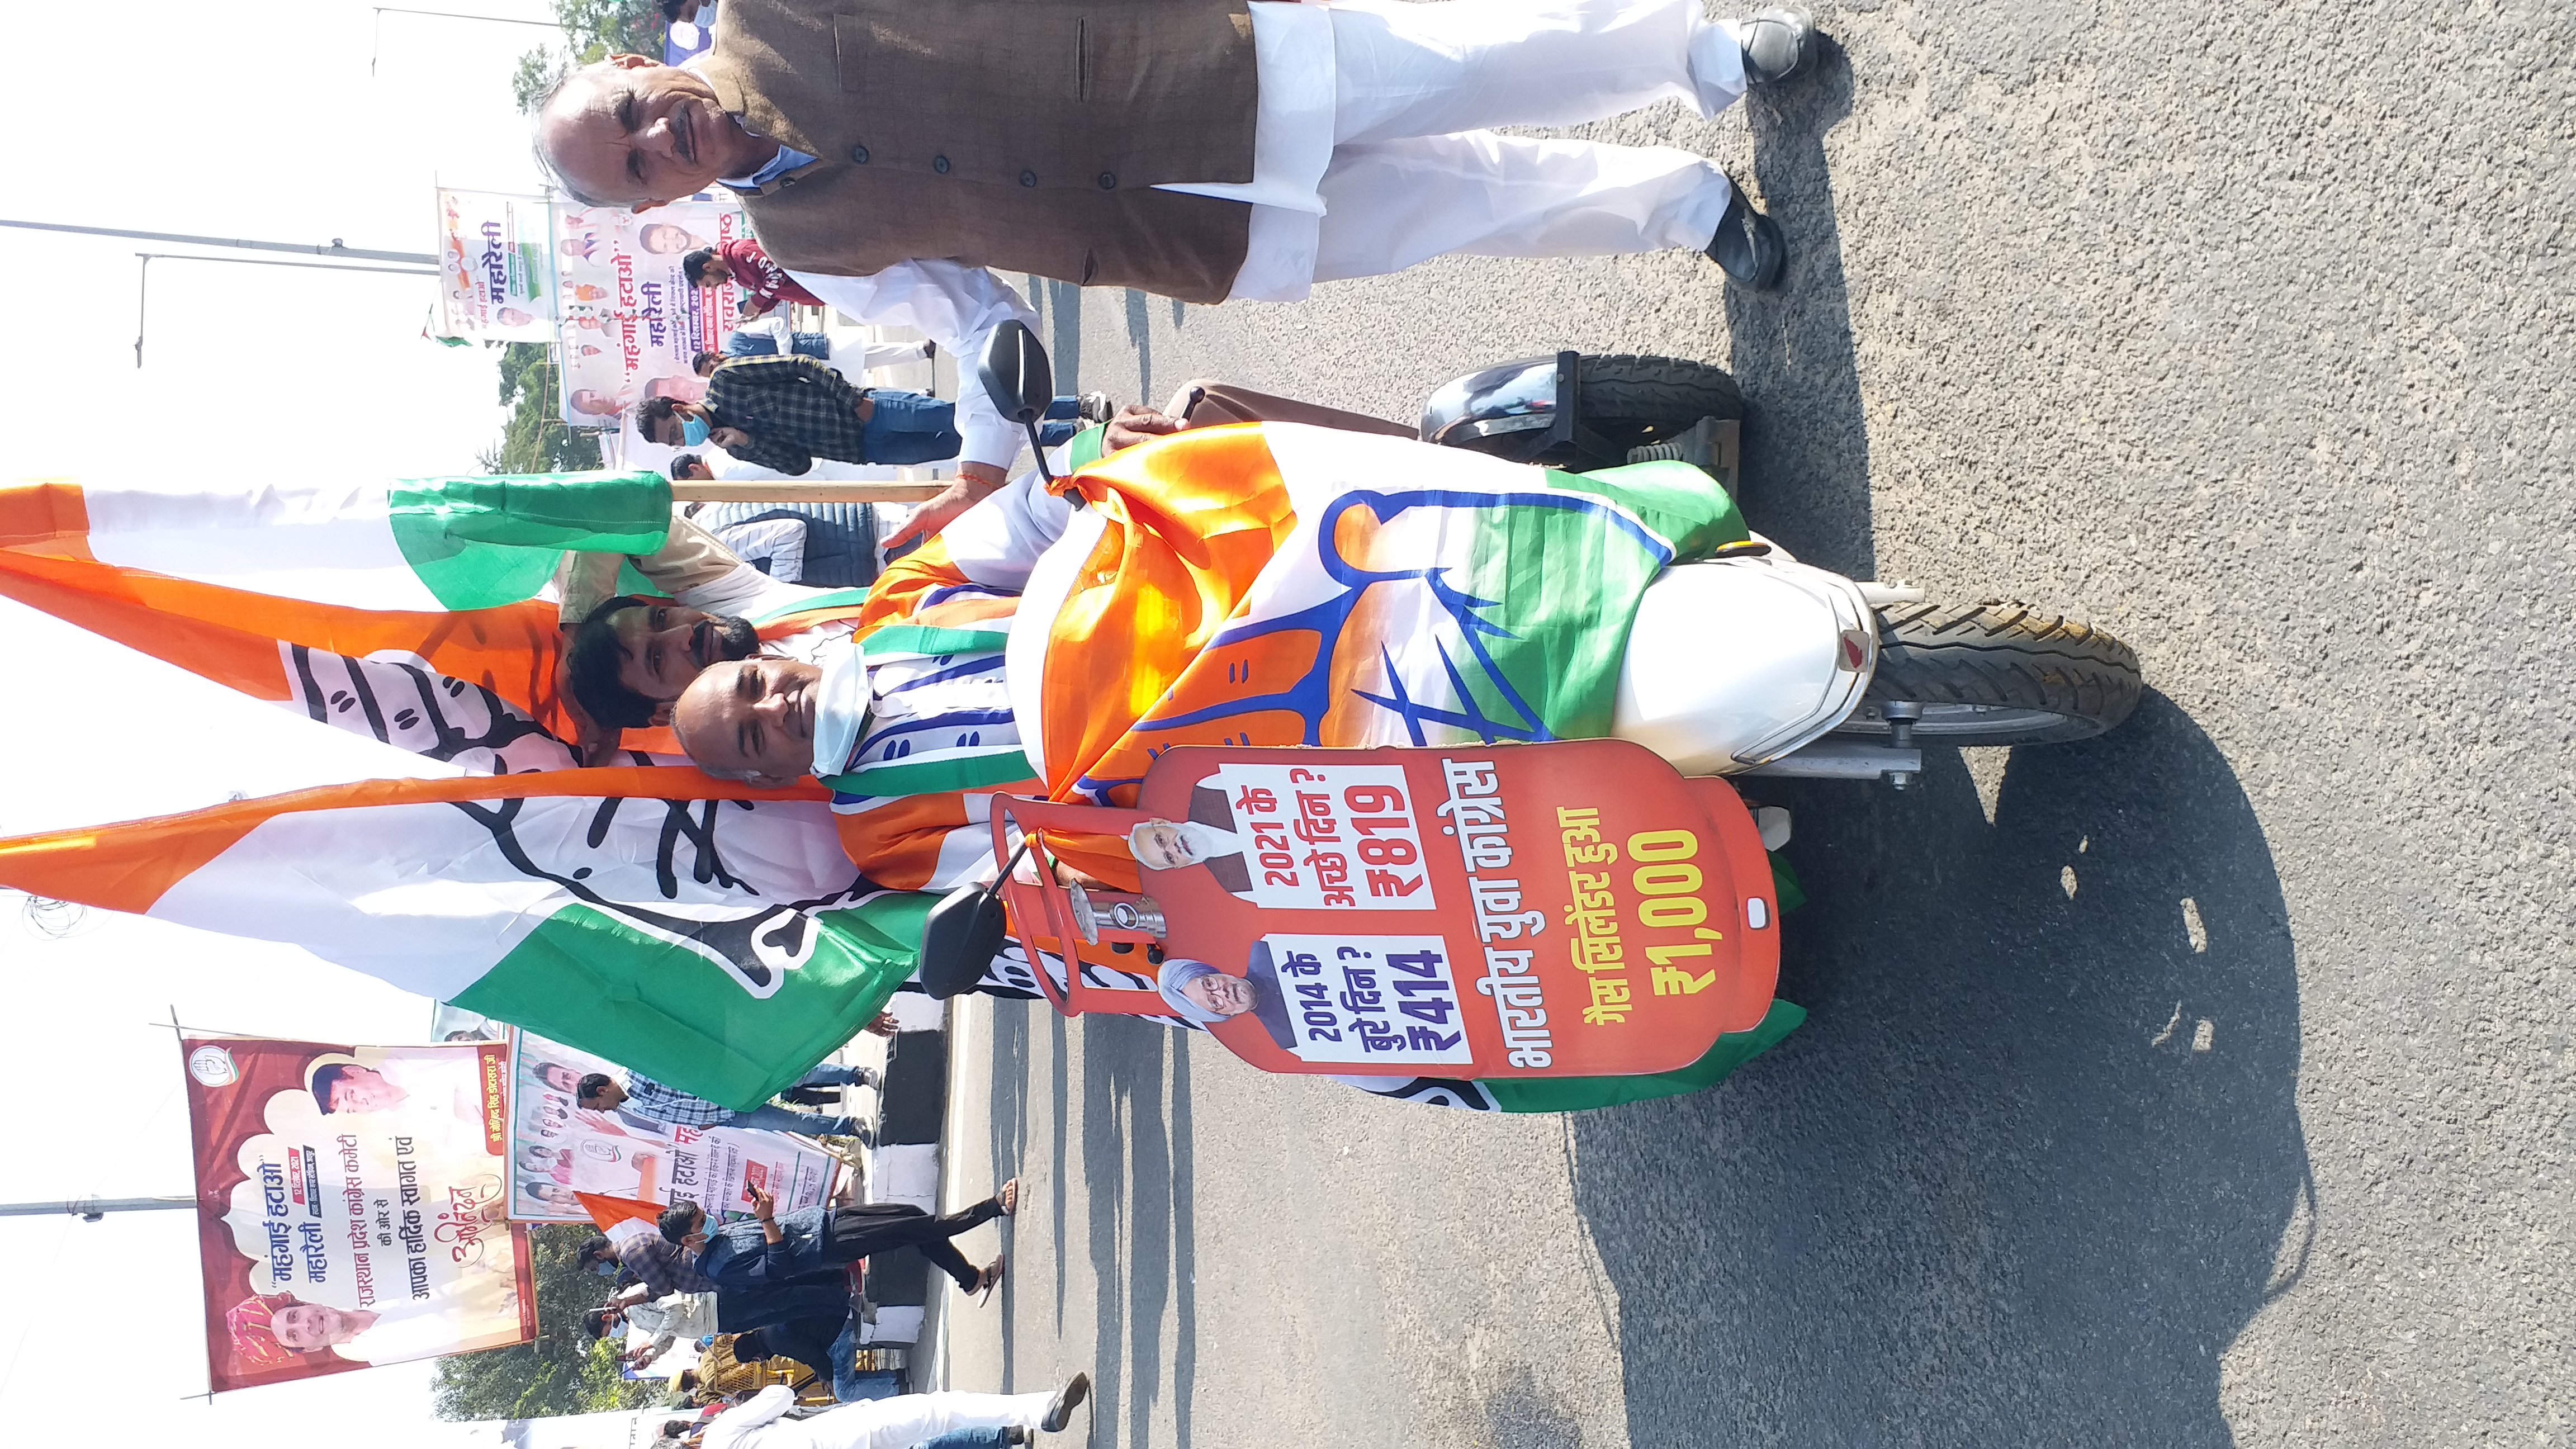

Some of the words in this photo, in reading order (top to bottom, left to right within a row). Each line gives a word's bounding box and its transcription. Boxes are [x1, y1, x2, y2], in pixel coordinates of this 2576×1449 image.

[481, 220, 506, 305] महारैली
[640, 281, 666, 347] महारैली
[691, 288, 699, 307] 202
[693, 341, 701, 349] 12
[1289, 768, 1327, 783] ?
[1236, 784, 1278, 814] के
[1292, 792, 1342, 845] दिन
[1436, 757, 1512, 873] कांग्रेस
[1251, 822, 1300, 887] 2021
[1343, 784, 1424, 897] ₹819
[1556, 806, 1618, 866] हुआ
[1303, 850, 1356, 906] अच्छे
[1469, 878, 1546, 942] युवा
[1564, 872, 1625, 973] सिलेंडर
[1627, 830, 1723, 997] ₹1,000
[1280, 951, 1322, 977] के
[1337, 946, 1372, 960] ?
[1294, 982, 1342, 1042] 2014
[1339, 968, 1388, 1014] दिन
[1386, 950, 1462, 1052] ₹414
[1475, 949, 1553, 1068] भारतीय
[1581, 977, 1633, 1026] गैस
[1353, 1017, 1407, 1053] बुरे
[484, 1054, 495, 1065] जी
[486, 1065, 498, 1093] डोटासरा
[486, 1094, 499, 1109] सिंह
[336, 1133, 359, 1173] कमेटी
[389, 1135, 414, 1156] एवं
[490, 1133, 502, 1142] श्री
[290, 1156, 300, 1169] 2021
[397, 1159, 421, 1207] स्वागत
[342, 1176, 366, 1216] कांग्रेस
[373, 1199, 389, 1209] से
[347, 1219, 371, 1250] प्रदेश
[375, 1210, 391, 1230] ओर
[377, 1233, 392, 1247] की
[398, 1209, 427, 1254] हार्दिक
[297, 1221, 328, 1283] महारैली
[353, 1252, 376, 1308] राजस्थान
[408, 1257, 430, 1301] आपका
